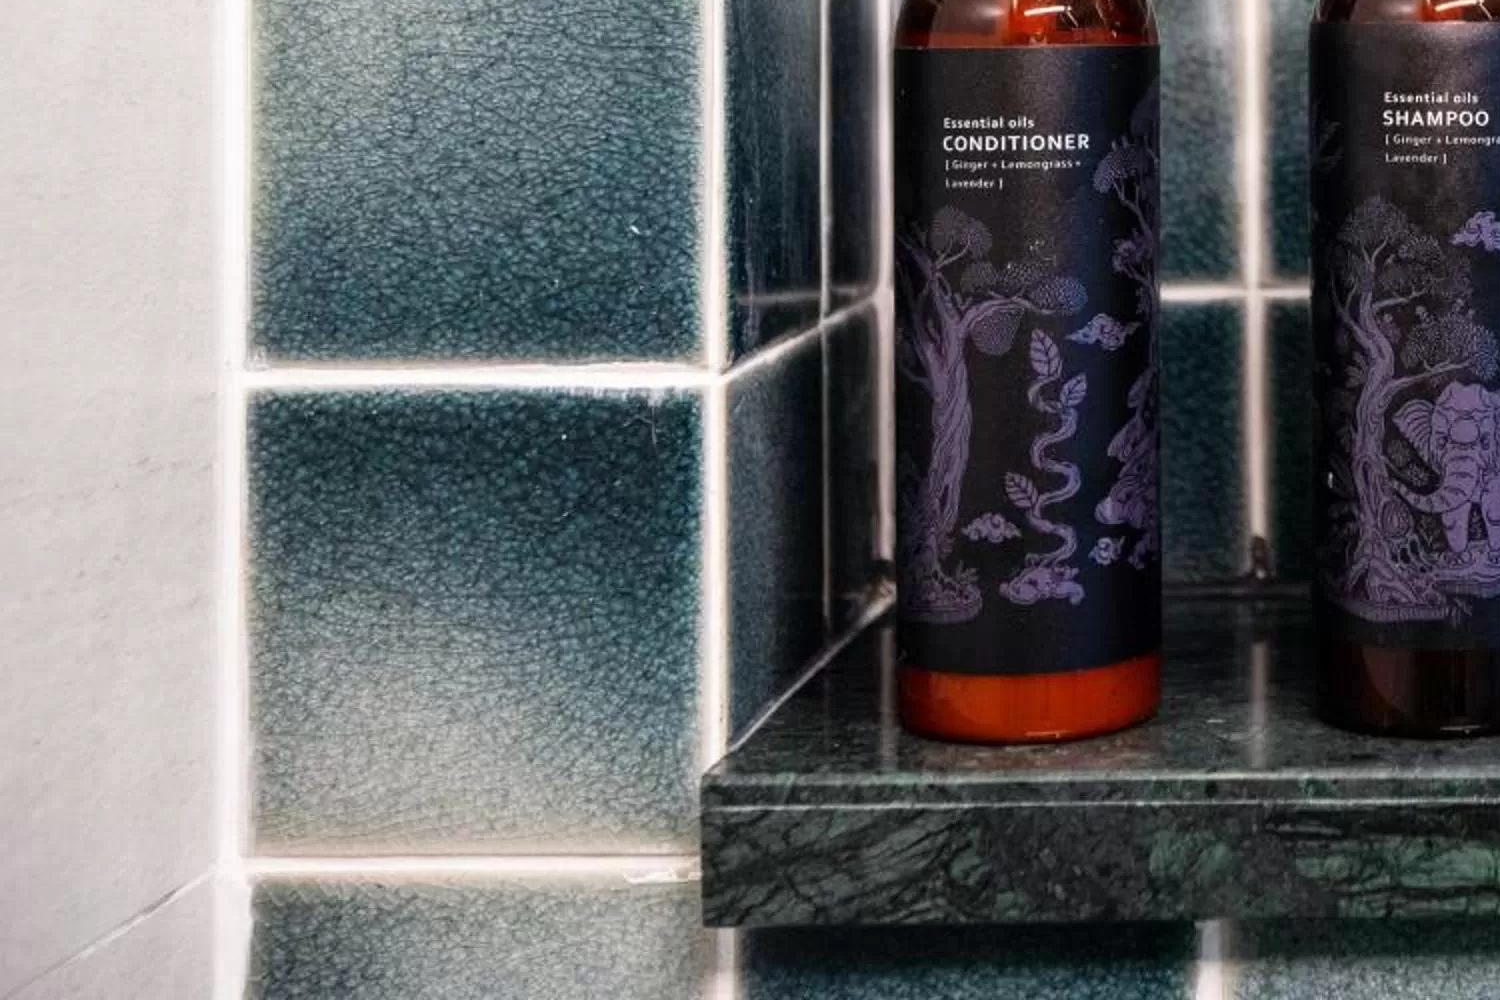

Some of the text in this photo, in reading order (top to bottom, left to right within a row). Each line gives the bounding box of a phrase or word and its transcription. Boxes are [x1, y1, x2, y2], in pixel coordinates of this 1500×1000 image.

[1383, 91, 1479, 104] Essential oils
[943, 116, 1035, 129] Essential oils
[1382, 110, 1490, 127] SHAMPOO
[942, 133, 1090, 152] CONDITIONER
[1392, 134, 1433, 147] Ginger
[1385, 153, 1439, 163] Lavender
[1000, 159, 1073, 171] Lemongrass
[945, 177, 995, 189] Lavender
